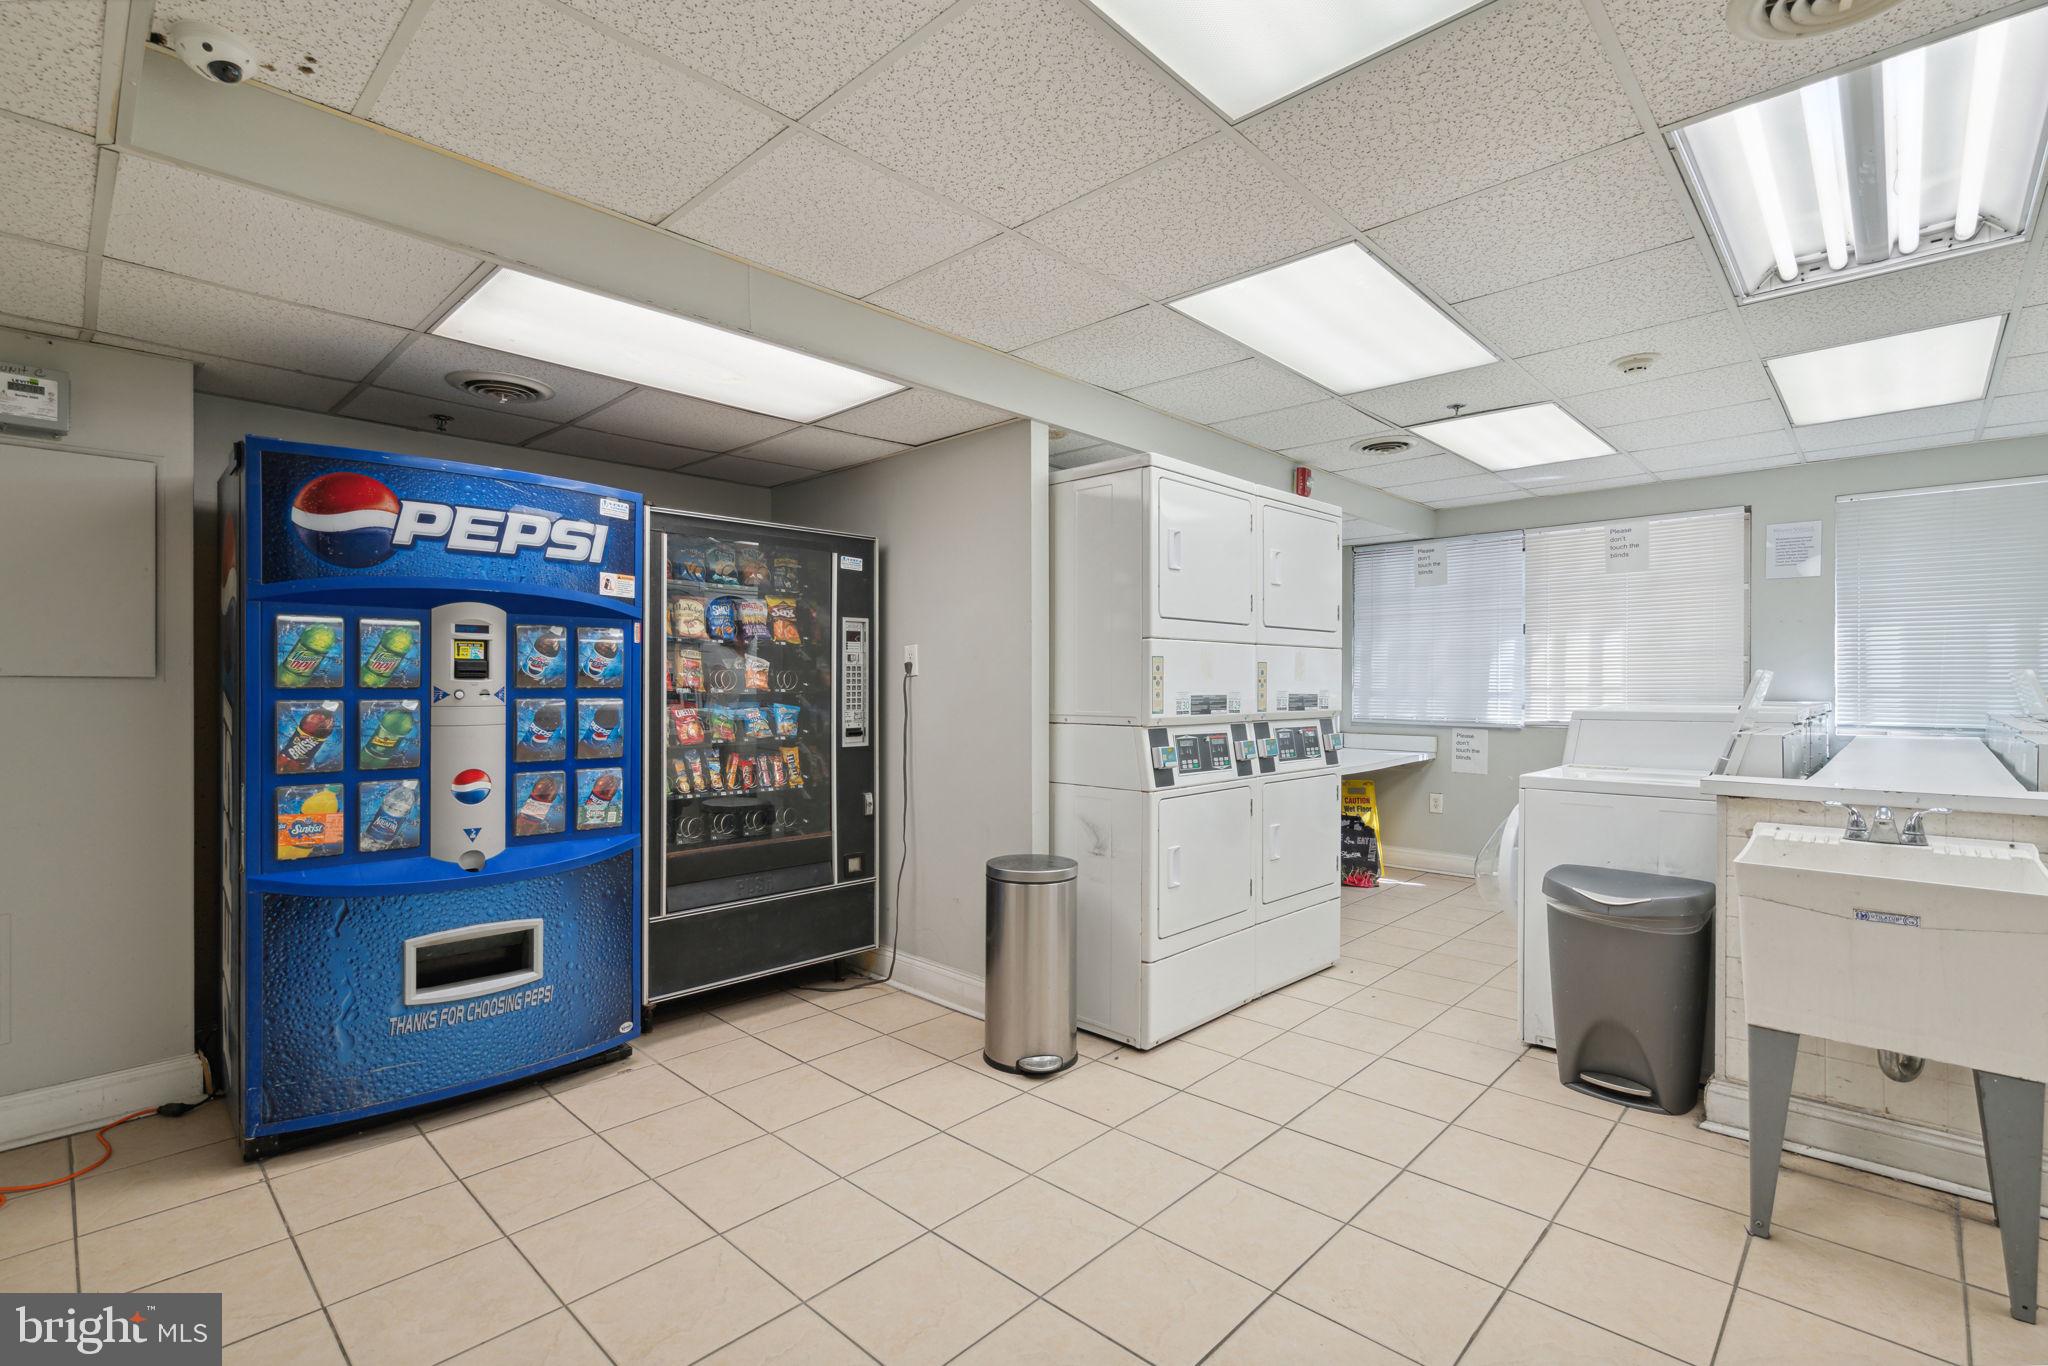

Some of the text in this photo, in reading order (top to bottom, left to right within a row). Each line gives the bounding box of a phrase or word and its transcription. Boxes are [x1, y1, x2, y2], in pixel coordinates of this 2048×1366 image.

[392, 500, 609, 563] PEPSI
[1357, 805, 1372, 813] Floor
[291, 822, 323, 835] Sunkist
[389, 985, 554, 1036] THANKS FOR CHOOSING PEPSI
